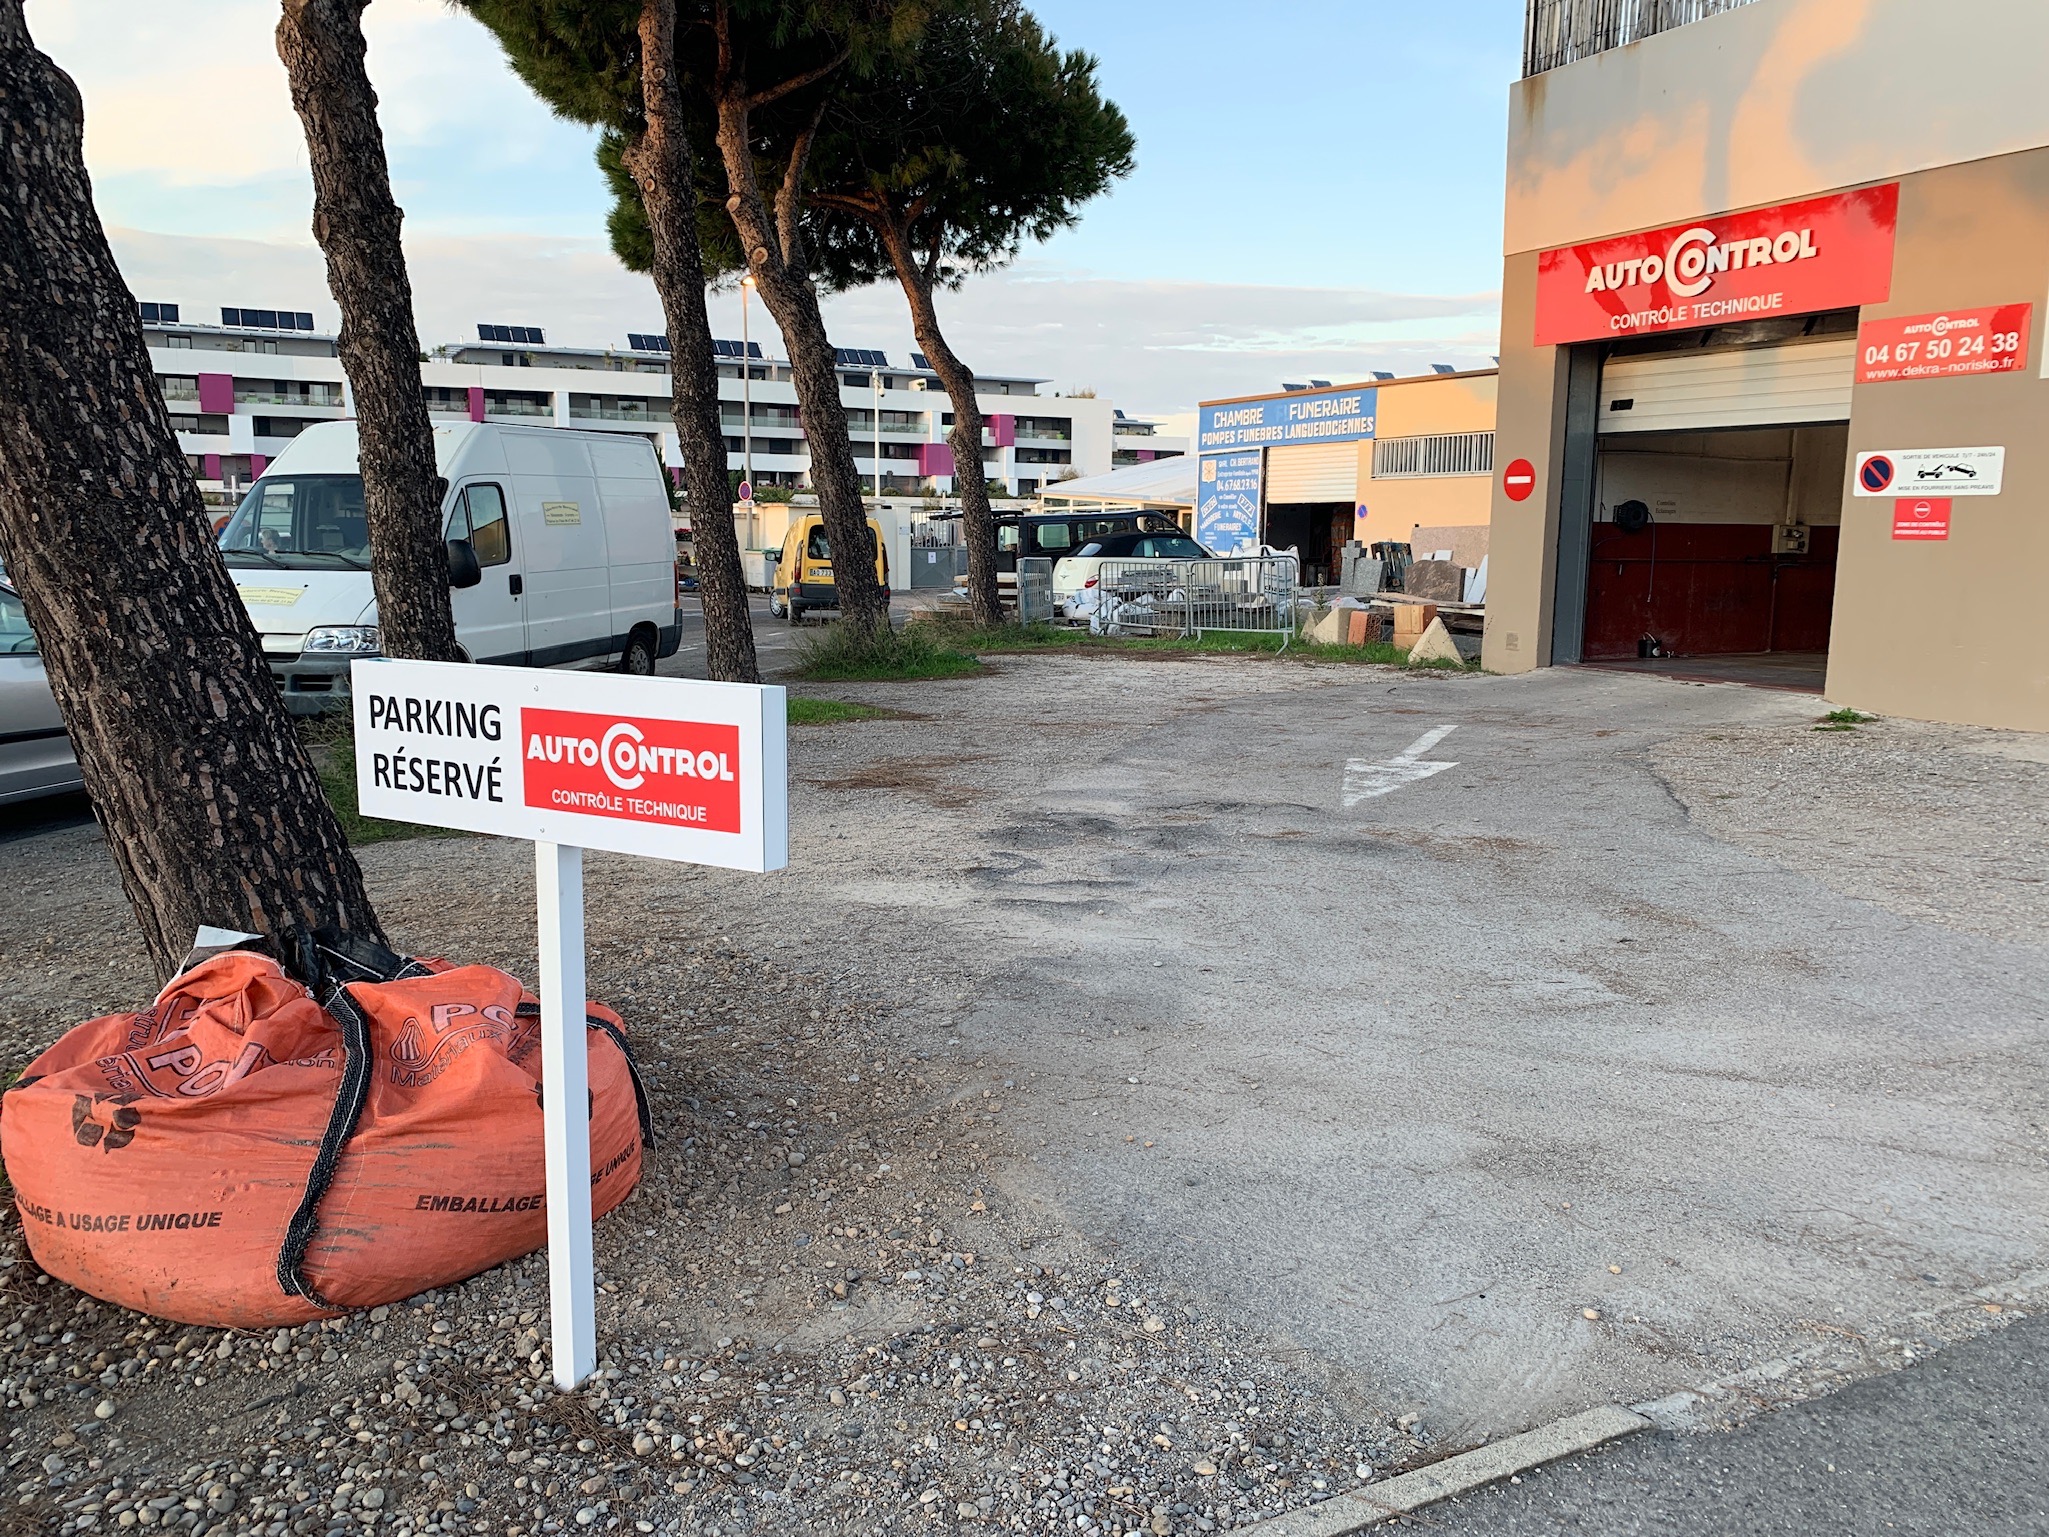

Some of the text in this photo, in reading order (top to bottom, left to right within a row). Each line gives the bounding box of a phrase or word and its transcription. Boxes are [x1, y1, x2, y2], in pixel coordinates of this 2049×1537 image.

[1610, 292, 1783, 330] CONTRÔLE TECHNIQUE
[1865, 331, 2019, 365] 04 67 50 24 38
[1866, 356, 2014, 380] www.dekra-norisko.fr
[1213, 407, 1264, 429] CHAMBRE
[1201, 430, 1235, 446] POMPES
[1237, 427, 1283, 443] FUNEBRES
[369, 694, 501, 741] PARKING
[373, 746, 503, 803] RÉSERVÉ
[551, 789, 707, 823] CONTRÔLE TECHNIQUE
[390, 1028, 504, 1088] Matériaux
[415, 1194, 545, 1214] EMBALLAGE
[69, 1213, 131, 1233] USAGE
[136, 1211, 223, 1231] UNIQUE
